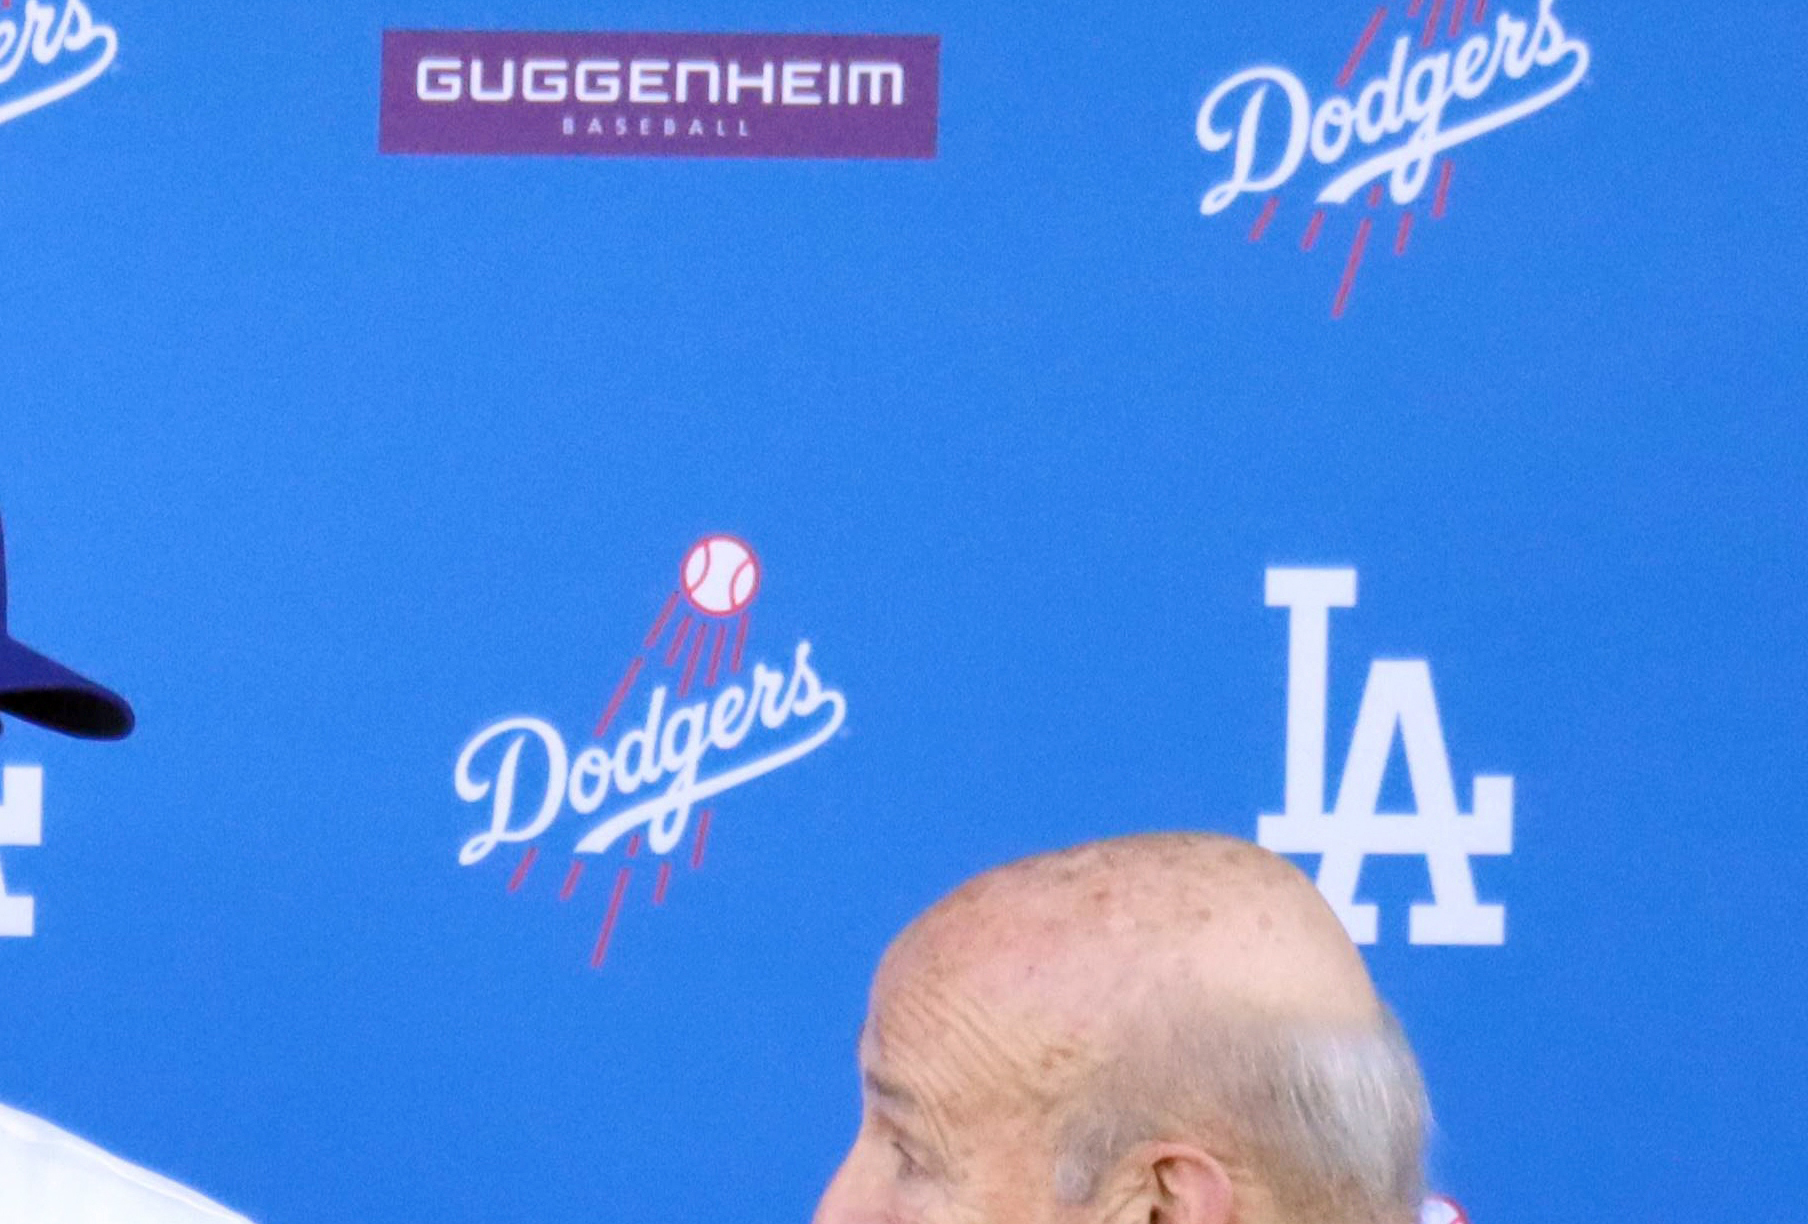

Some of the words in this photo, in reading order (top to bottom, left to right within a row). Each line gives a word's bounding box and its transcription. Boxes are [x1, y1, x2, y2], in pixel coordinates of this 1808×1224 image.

[415, 57, 905, 106] GUGGENHEIM
[562, 117, 750, 137] BASEBALL
[1195, 0, 1590, 216] Dodgers
[454, 640, 846, 866] Dodgers
[1257, 566, 1514, 946] LA
